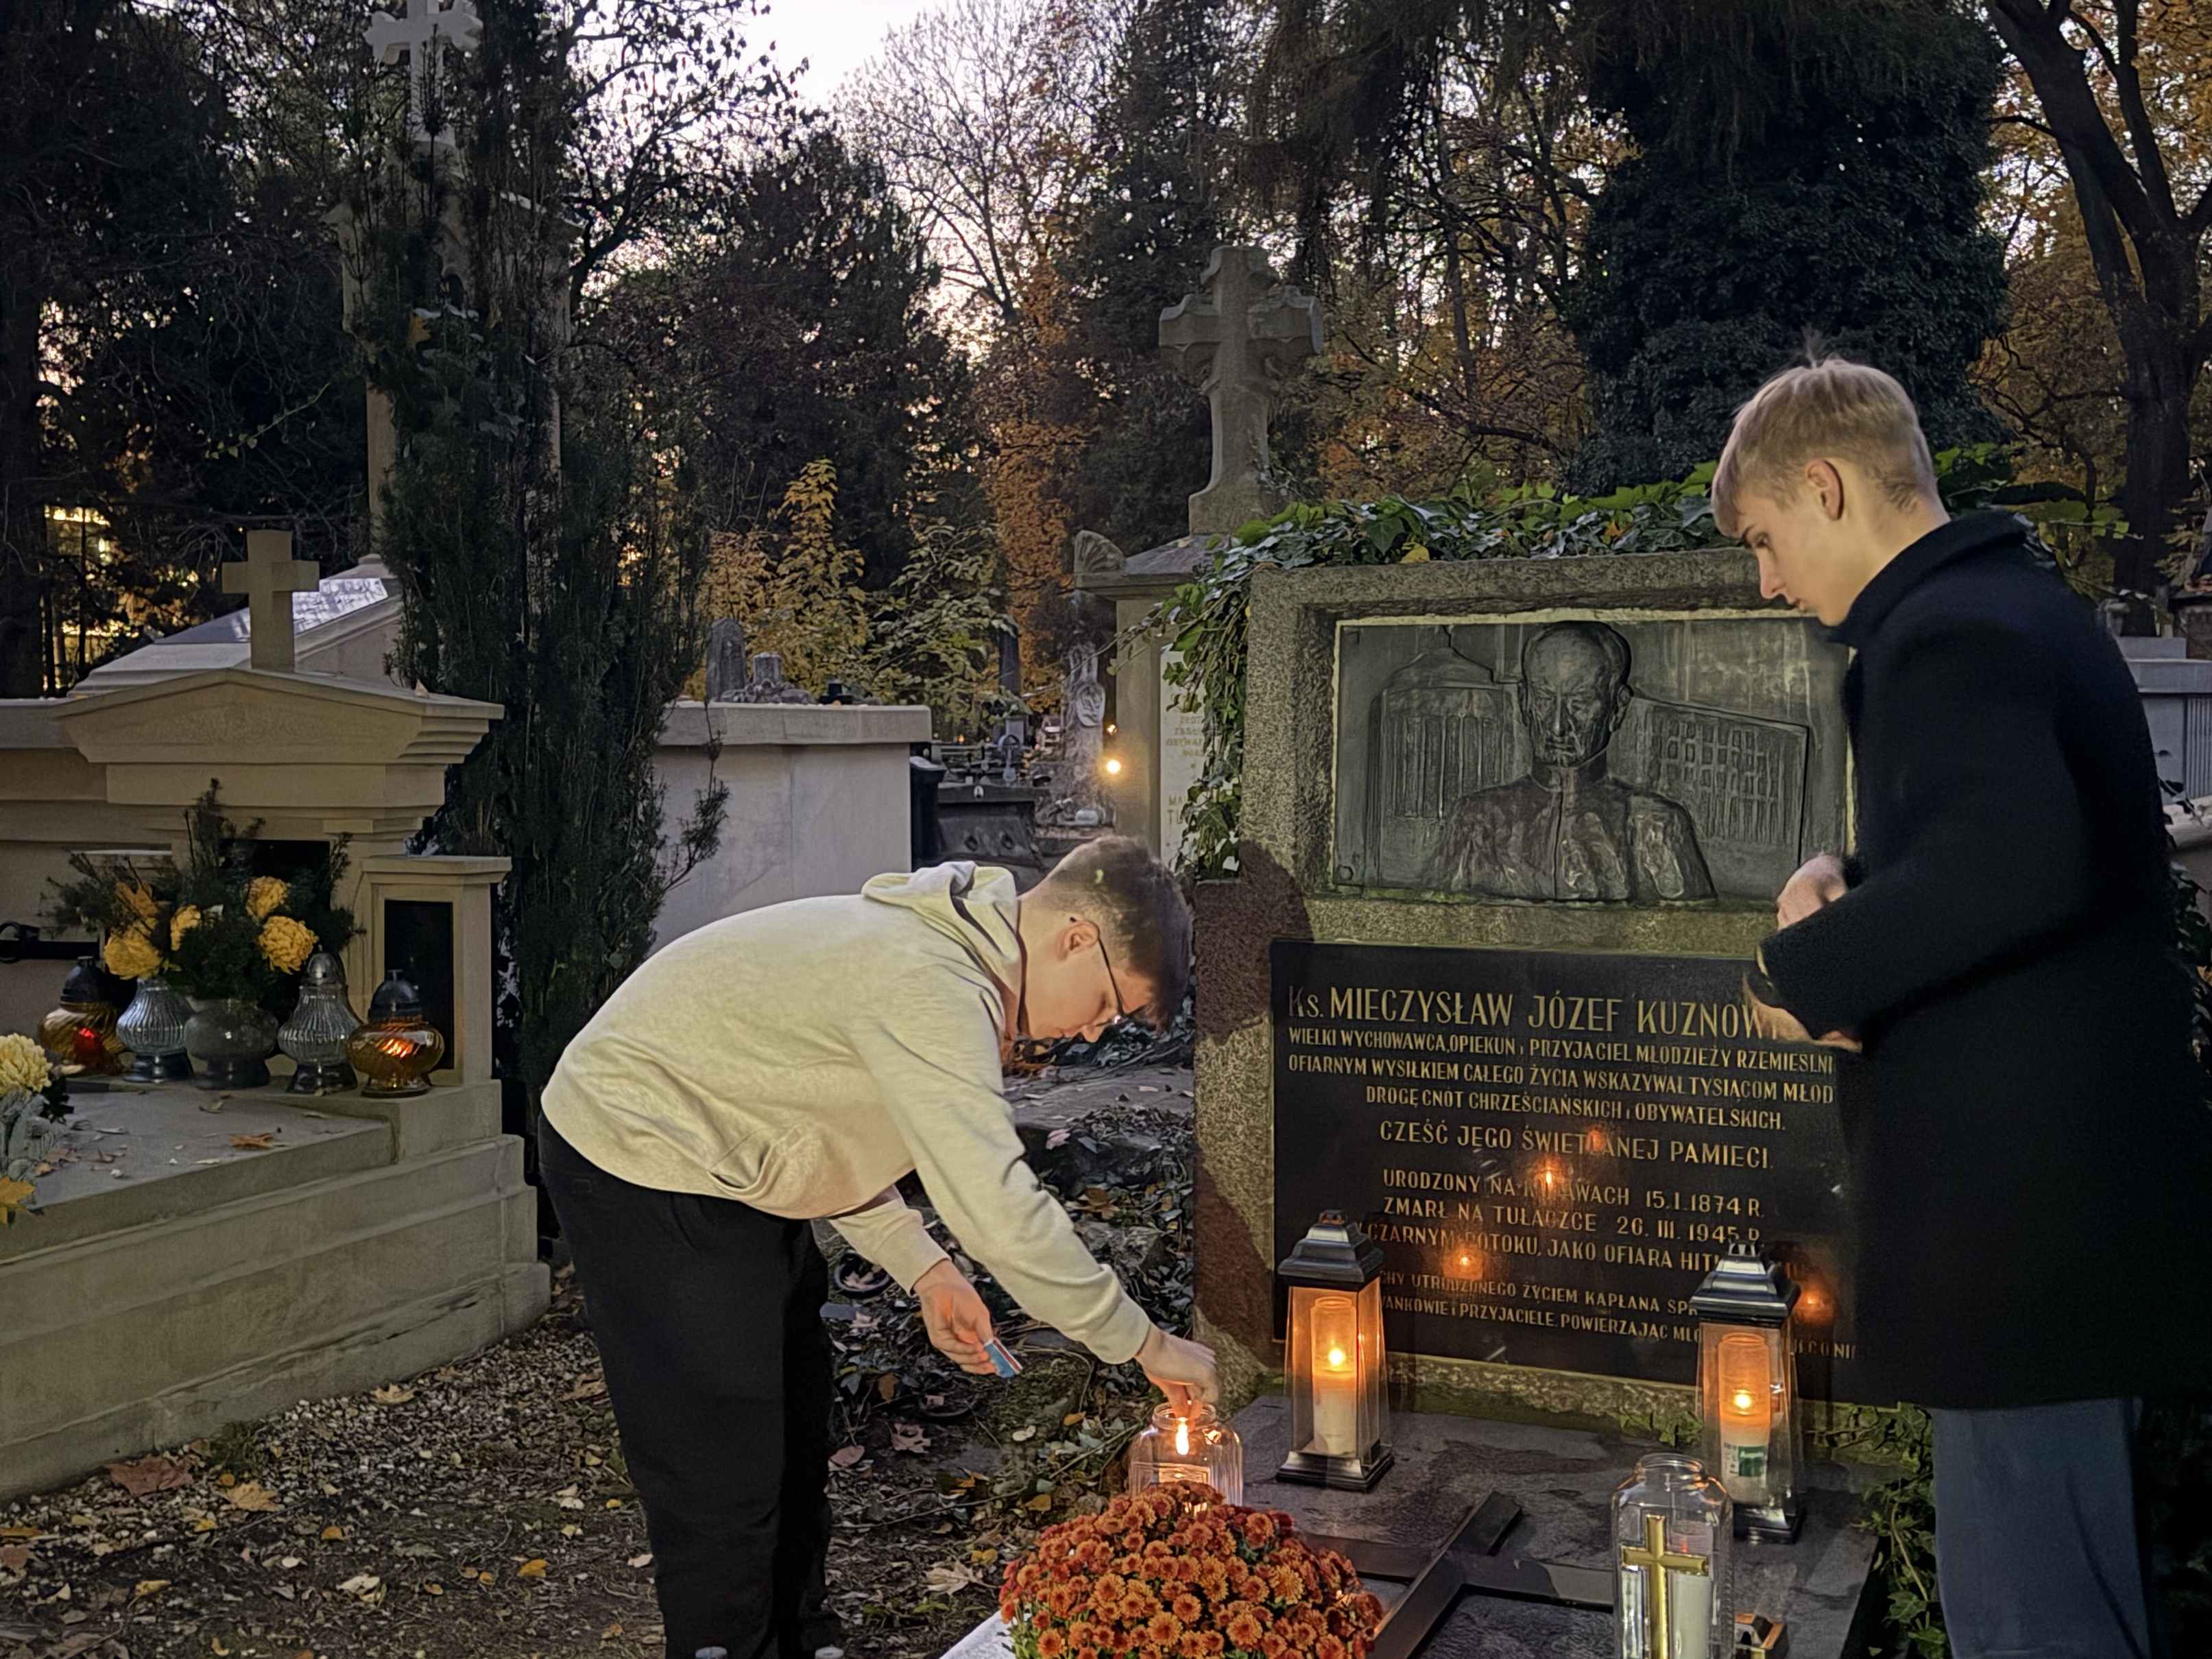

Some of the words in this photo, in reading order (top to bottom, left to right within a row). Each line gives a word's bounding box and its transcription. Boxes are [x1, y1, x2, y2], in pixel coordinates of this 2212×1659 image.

[1288, 986, 1324, 1018] Ks.
[1330, 987, 1513, 1027] MIECZYSŁAW
[1528, 990, 1623, 1031] JÓZEF
[1288, 1027, 1336, 1046] WIELKI
[1530, 1038, 1632, 1062] PRZYJACIEL
[1636, 1044, 1731, 1068] MŁODZIEŻY
[1288, 1054, 1367, 1075] OFIARNYM
[1371, 1058, 1458, 1081] WYSIŁKIEM
[1463, 1064, 1524, 1084] CAŁEGO
[1530, 1064, 1578, 1088] ŻYCIA
[1689, 1077, 1777, 1102] TYSIĄCOM
[1783, 1082, 1834, 1103] MŁOD
[1367, 1086, 1418, 1108] DROGĘ
[1635, 1103, 1786, 1131] OBYWATELSKICH.
[1380, 1119, 1448, 1145] CZEŚĆ
[1458, 1125, 1511, 1149] JEGO
[1383, 1169, 1480, 1193] URODZONY
[1491, 1176, 1515, 1197] NA
[1384, 1197, 1448, 1219] ZMARŁ
[1458, 1203, 1483, 1221] NA
[1547, 1239, 1596, 1261] JAKO
[1604, 1245, 1673, 1268] OFIARA
[1681, 1252, 1718, 1272] HIT
[1523, 1282, 1577, 1304] ŻYCIEM
[1585, 1291, 1660, 1313] KAPŁANA
